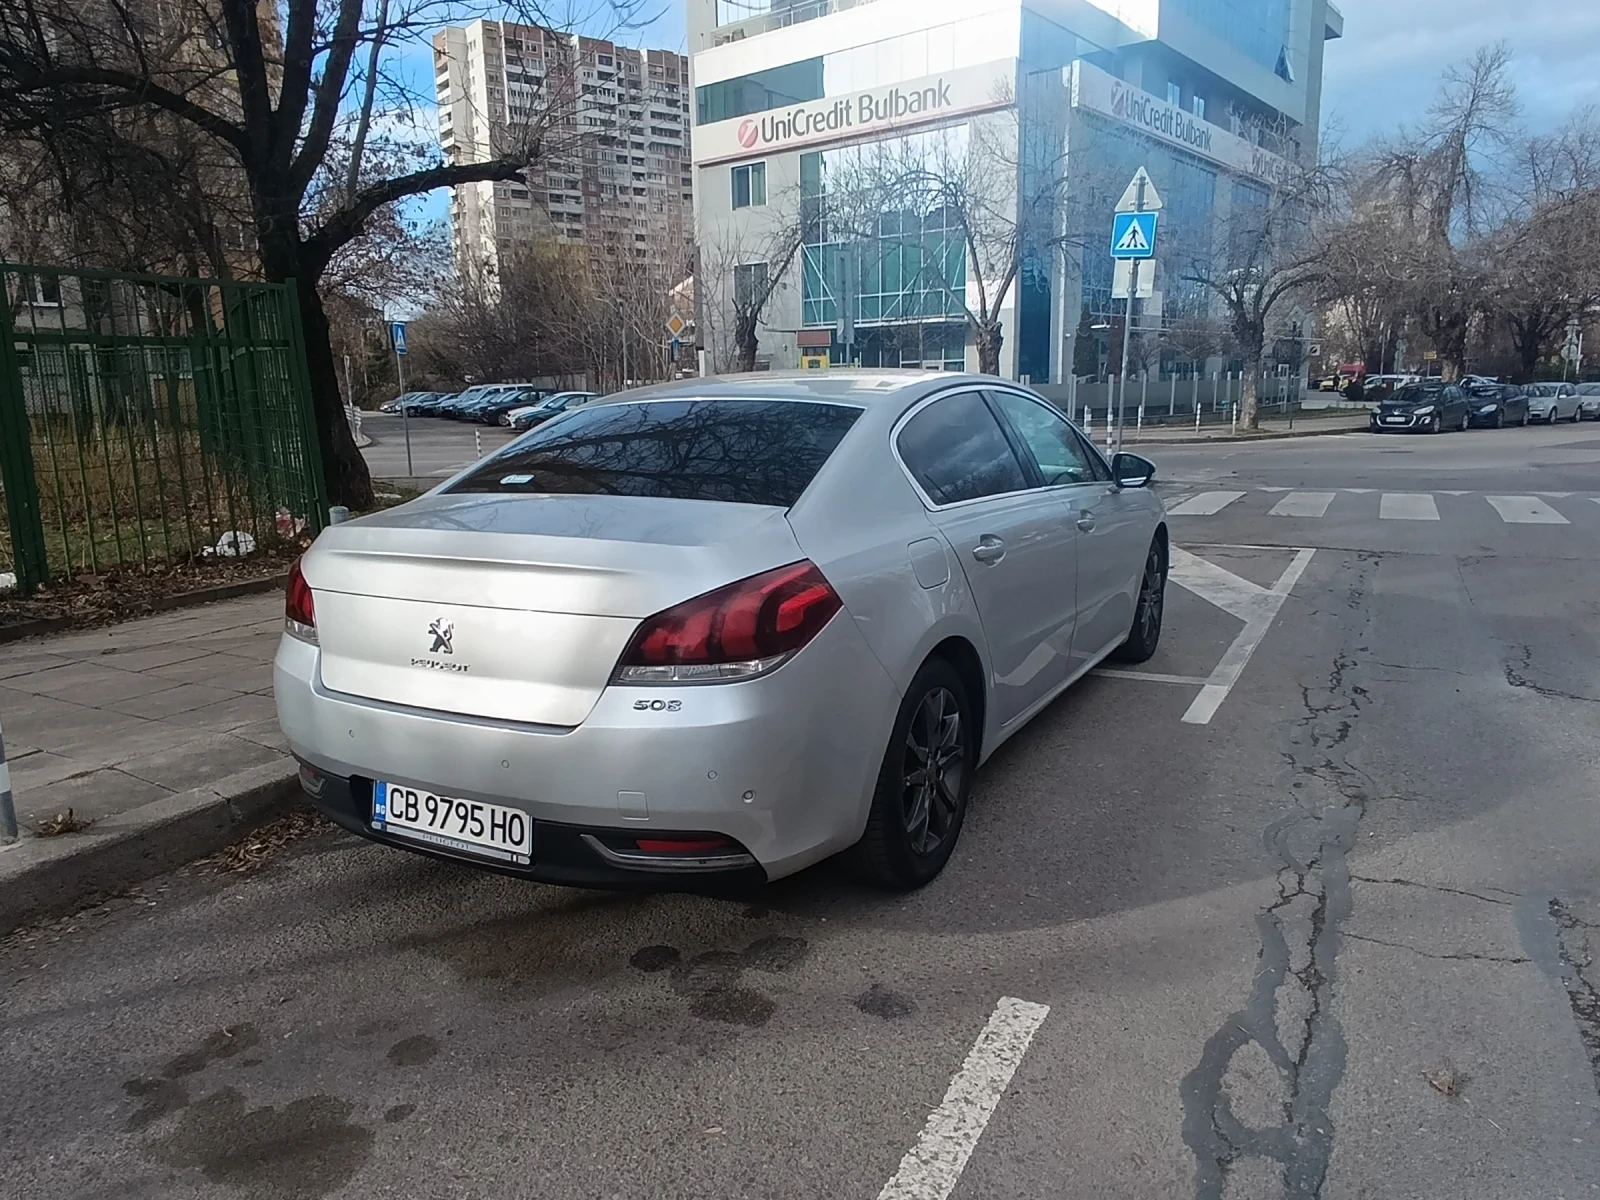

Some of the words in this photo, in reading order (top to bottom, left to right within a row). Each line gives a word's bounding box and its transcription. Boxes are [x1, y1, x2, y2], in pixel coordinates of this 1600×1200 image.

[761, 100, 852, 143] UniCredit
[858, 78, 952, 124] Bulbank
[1125, 89, 1174, 137] UniCredit
[1175, 112, 1212, 152] Bulbank
[633, 699, 682, 712] 508
